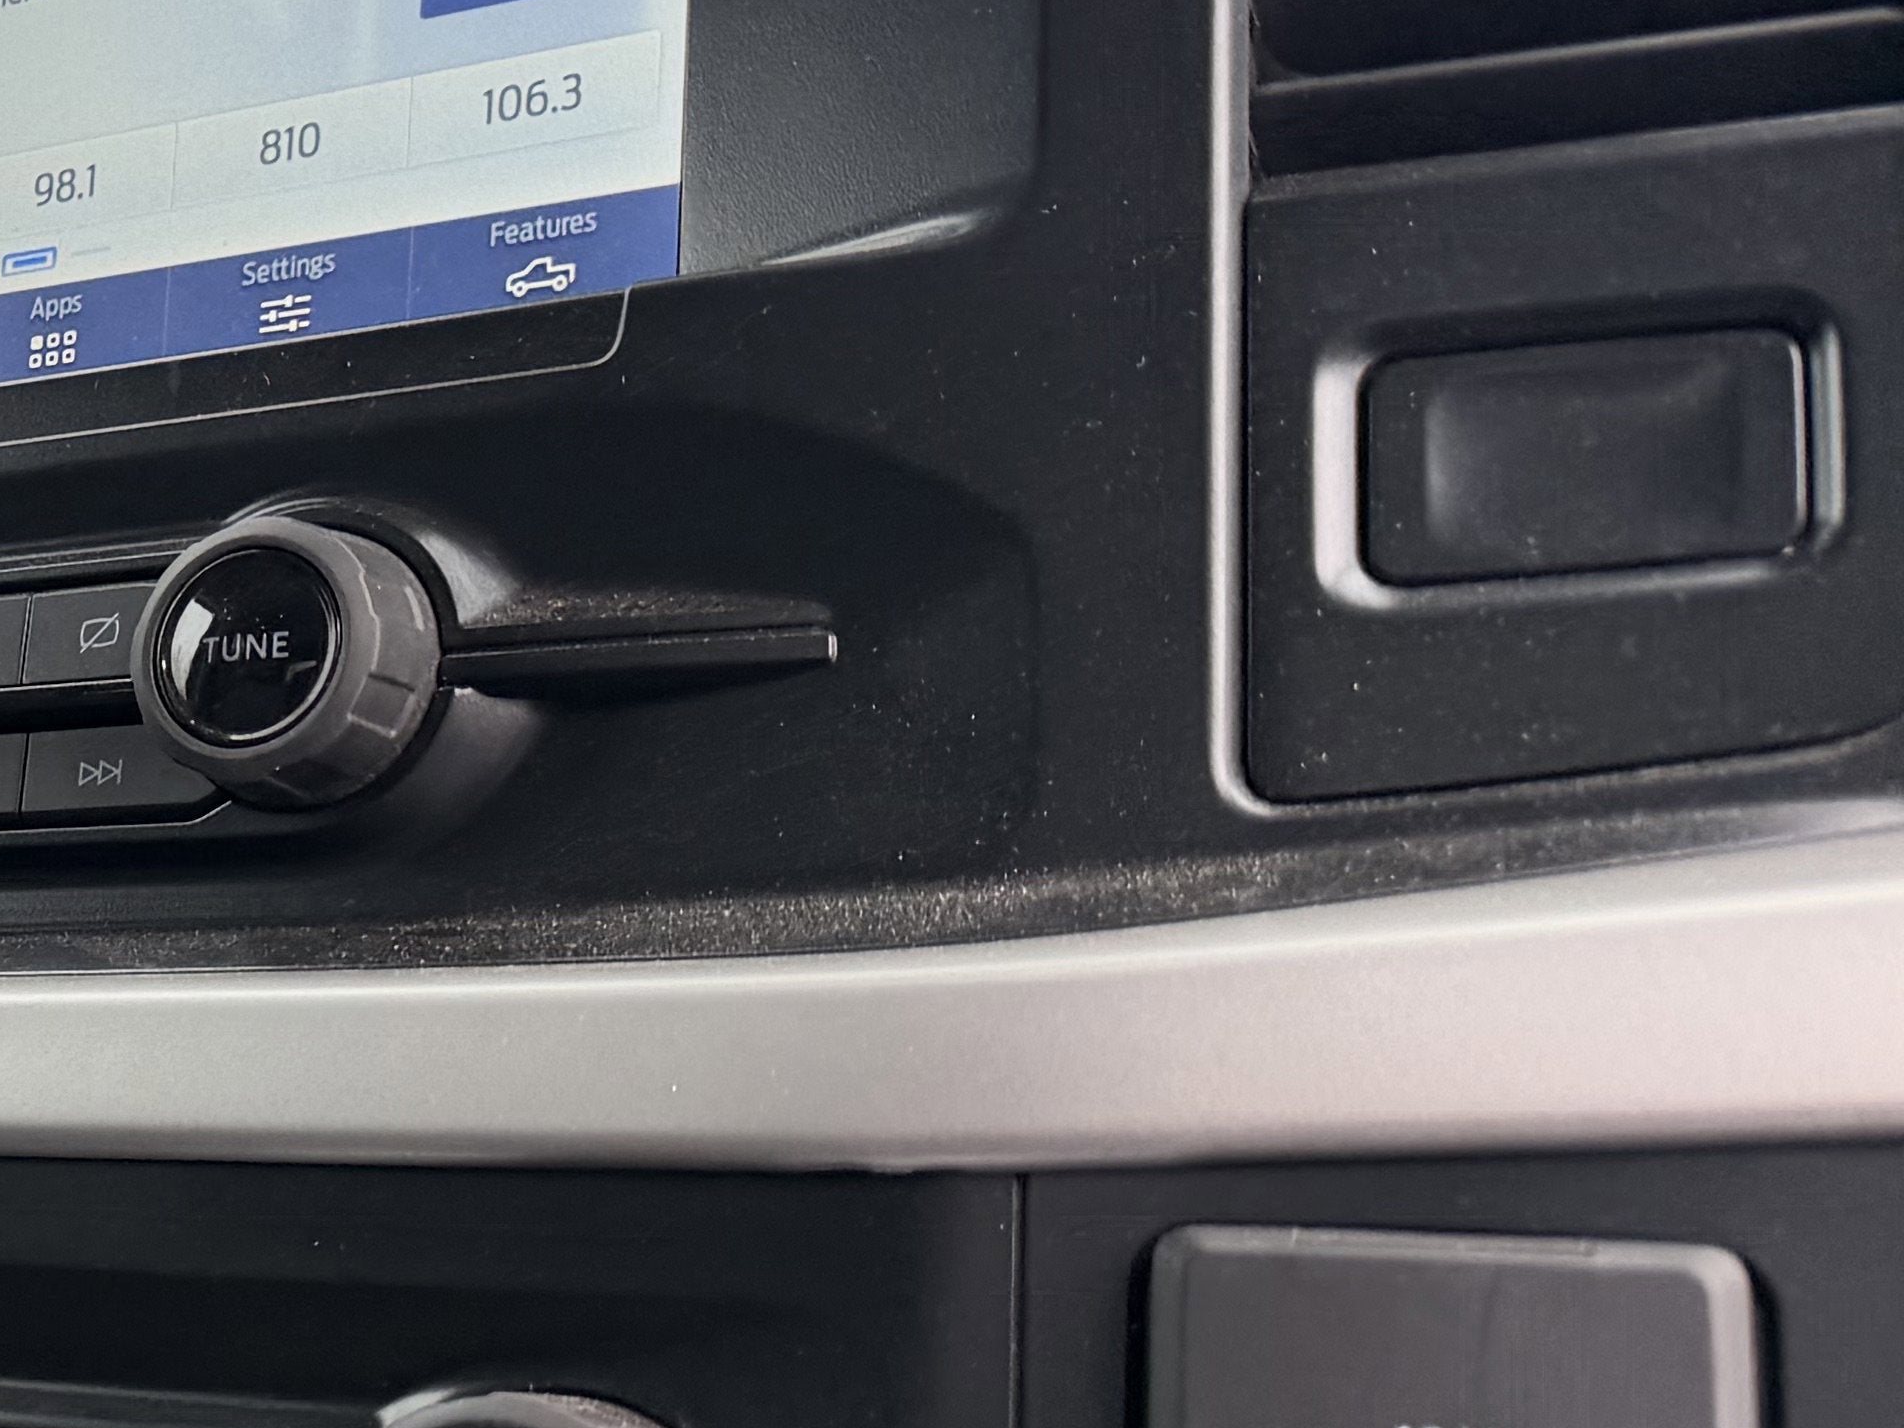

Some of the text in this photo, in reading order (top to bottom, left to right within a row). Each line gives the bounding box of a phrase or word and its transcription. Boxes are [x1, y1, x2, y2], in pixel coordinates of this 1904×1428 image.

[482, 73, 583, 124] 106.3
[259, 122, 321, 165] 810
[33, 164, 97, 207] 98.1
[490, 211, 598, 247] Features
[241, 251, 336, 287] Settings
[30, 292, 82, 321] Apps
[205, 632, 290, 664] TUNE
